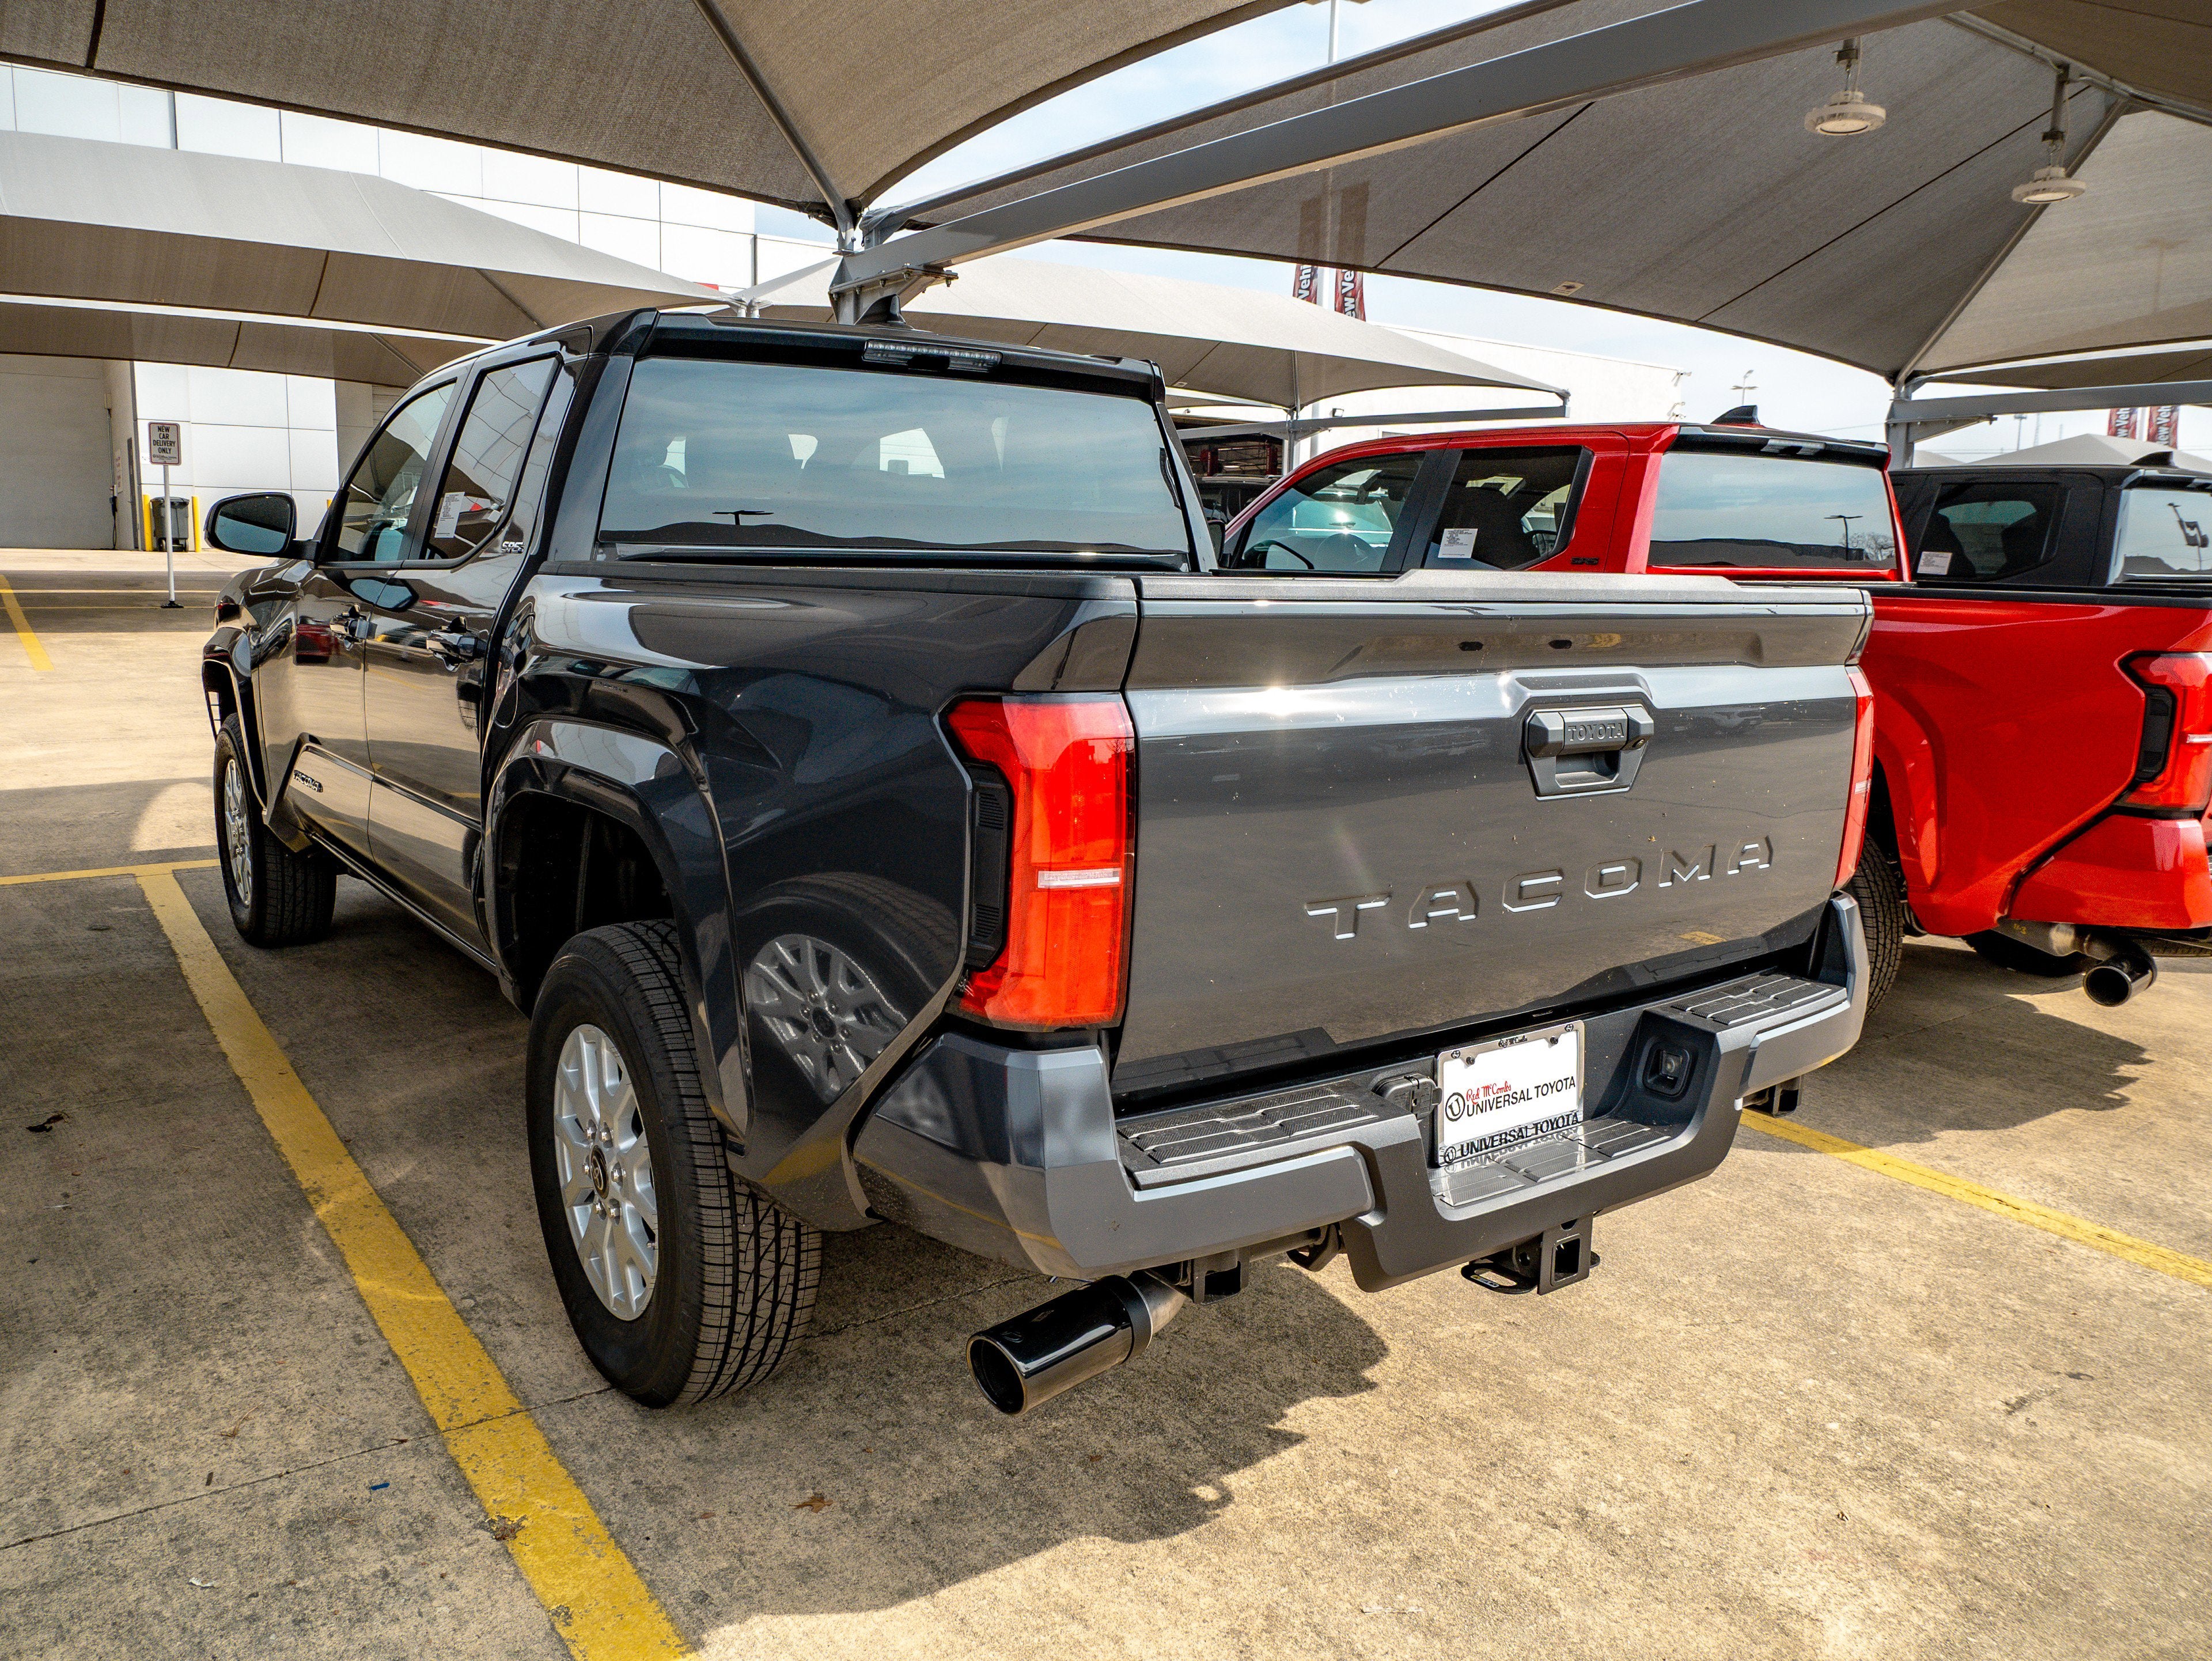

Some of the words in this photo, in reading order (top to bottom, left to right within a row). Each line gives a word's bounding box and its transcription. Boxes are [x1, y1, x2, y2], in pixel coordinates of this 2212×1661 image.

[1341, 269, 1355, 295] Ve
[1567, 722, 1626, 742] TOYOTA
[293, 769, 324, 793] TACOMA
[1303, 835, 1774, 940] TACOMA
[1466, 1087, 1480, 1104] Red
[1467, 1089, 1533, 1117] UNIVERSAL
[1534, 1076, 1576, 1098] TOYOTA
[1460, 1125, 1533, 1157] UNIVERSAL
[1533, 1113, 1580, 1134] TOYOTA
